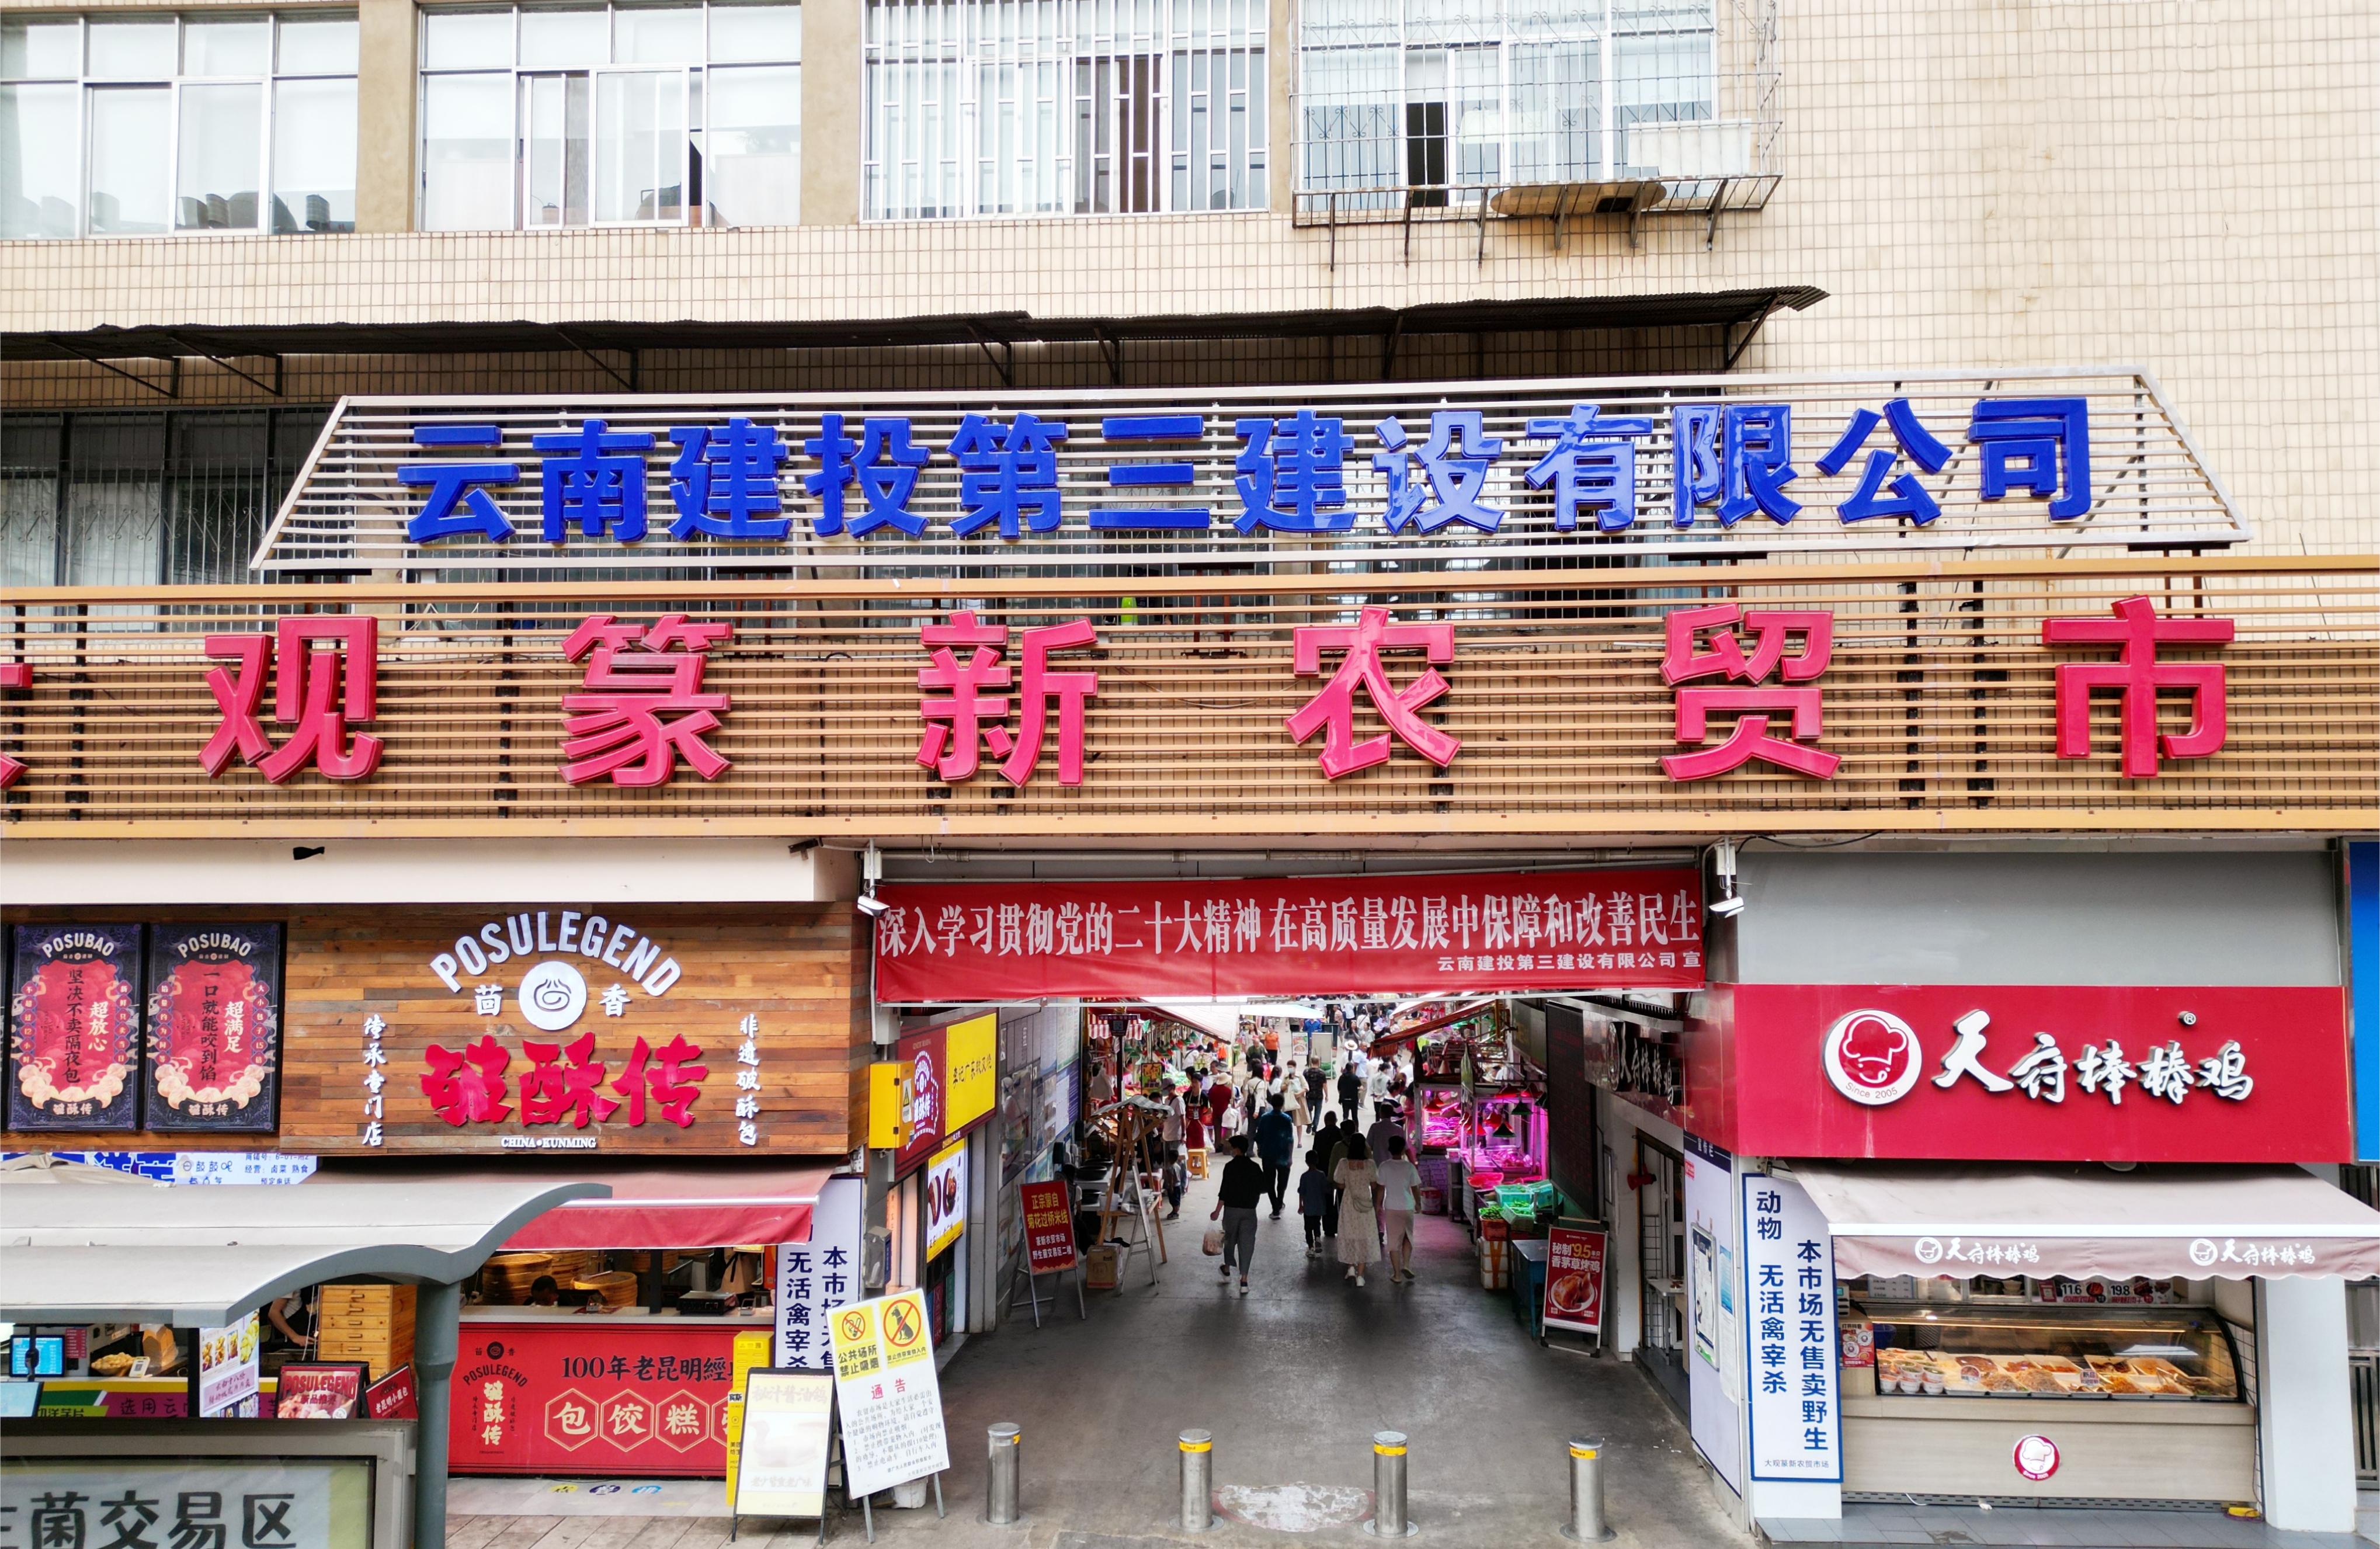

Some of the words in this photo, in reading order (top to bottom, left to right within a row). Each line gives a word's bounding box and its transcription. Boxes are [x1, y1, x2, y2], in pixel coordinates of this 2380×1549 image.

[397, 398, 2089, 543] 云南建投第三建设有限公司
[0, 595, 2235, 789] 观篆新农贸市
[42, 933, 114, 958] POSUBAO
[177, 933, 251, 958] POSUBAO
[430, 911, 682, 996] POSULEGEND
[474, 985, 502, 1016] 茴
[598, 984, 631, 1017] 香
[64, 970, 85, 1083] 坚决不卖隔夜包
[88, 1001, 109, 1051] 超放心
[199, 972, 219, 1081] 一口就能咬到馅
[224, 1001, 244, 1053] 超满足
[1932, 1009, 2254, 1105] 天府棒棒鸡
[735, 1013, 760, 1145] 非遗破酥包
[1846, 1082, 1870, 1098] Since
[1875, 1087, 1898, 1099] 2005
[1031, 1192, 1059, 1210] 正宗蒙自
[1756, 1190, 1782, 1240] 动物
[1027, 1209, 1068, 1229] 菊花过桥米线
[1552, 1242, 1571, 1256] 秘制
[1945, 1237, 2040, 1266] 天府棒棒鸡
[2220, 1238, 2316, 1266] 天府棒棒鸡
[2062, 1284, 2082, 1294] 11.6
[2111, 1286, 2130, 1296] 19.8
[1759, 1264, 1787, 1394] 无活禽宰杀
[838, 1345, 877, 1364] 公共场所
[1797, 1239, 1829, 1451] 本市场无售卖野生
[463, 1364, 527, 1387] POSULEGEND
[840, 1357, 880, 1377] 禁止吸烟
[284, 1375, 358, 1400] POSULEGEND
[120, 1397, 188, 1416] 选用云
[1764, 1458, 1829, 1468] 大观篆新农贸市场
